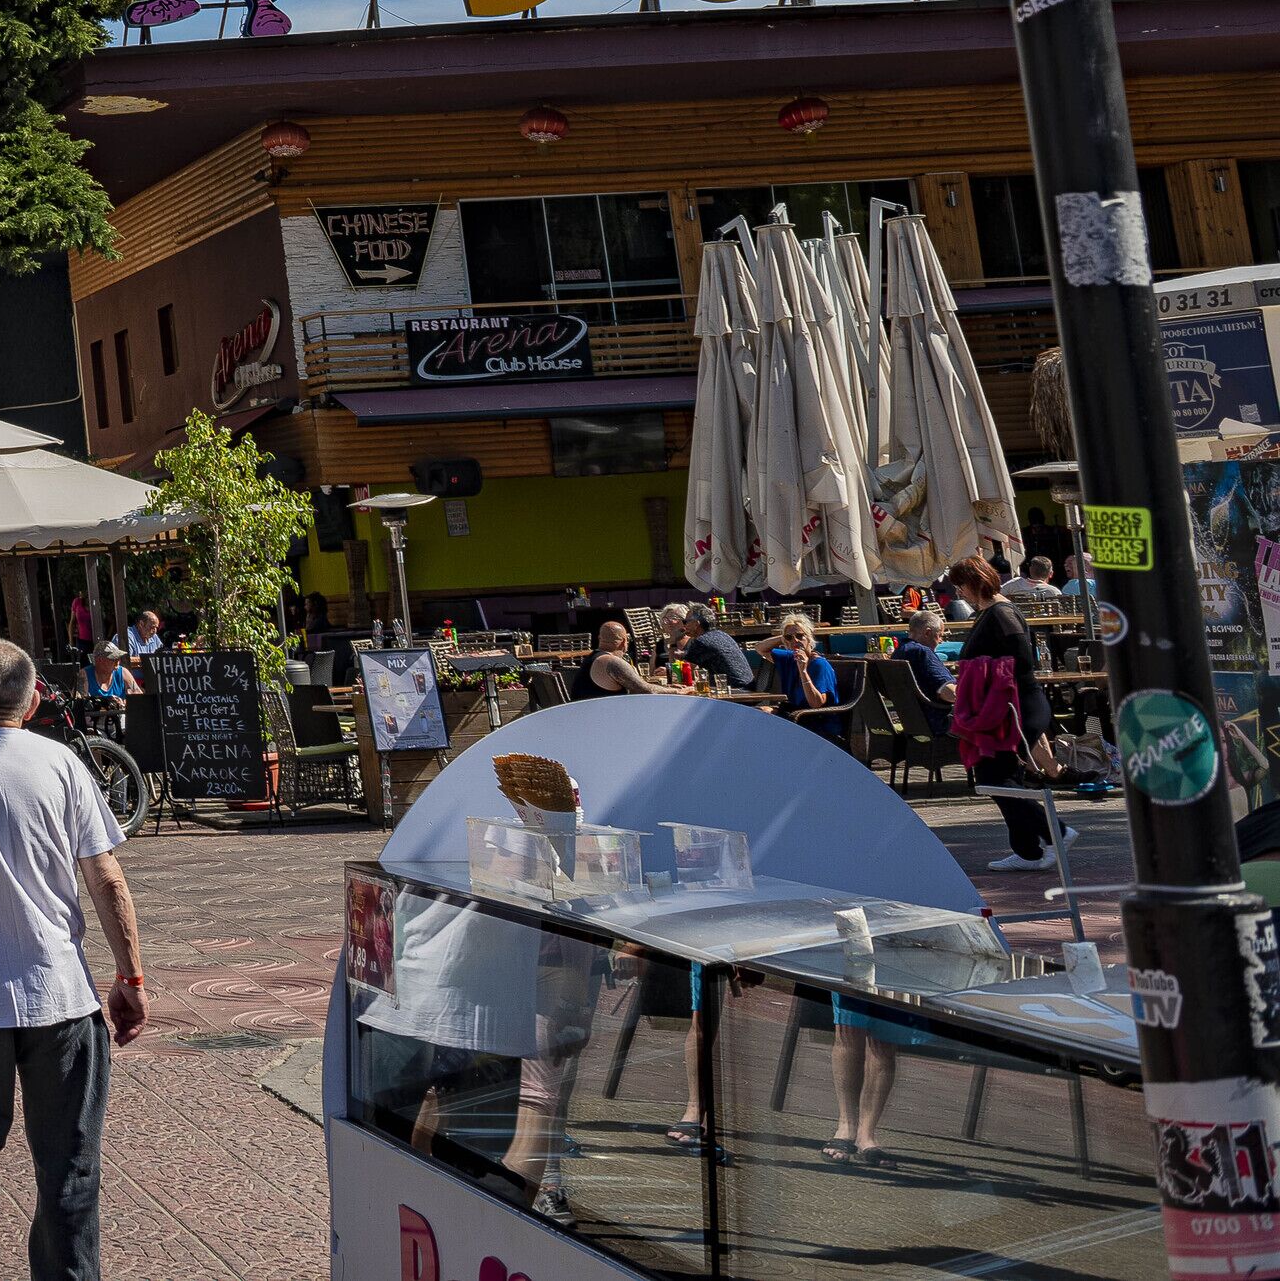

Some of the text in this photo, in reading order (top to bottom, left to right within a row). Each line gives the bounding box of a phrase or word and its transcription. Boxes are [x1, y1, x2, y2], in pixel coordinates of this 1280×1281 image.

[327, 211, 430, 236] CHINESE
[353, 239, 412, 262] FOOD
[1176, 288, 1233, 312] 31 31
[411, 317, 510, 332] RESTAURANT
[435, 321, 569, 369] Arena
[485, 355, 584, 373] Club House
[1166, 360, 1208, 373] URITY
[1086, 510, 1143, 525] LLOCKS
[1093, 524, 1142, 537] BREXIT
[1088, 538, 1145, 553] LLOCKS
[1097, 551, 1140, 565] BORIS
[1212, 624, 1243, 634] ВСИЧКО
[387, 658, 408, 669] MIX
[162, 655, 250, 692] HAPPY 24/7
[165, 675, 216, 694] HOUR
[176, 693, 195, 705] ALL
[166, 705, 188, 720] Buy
[195, 718, 233, 731] FREE
[182, 743, 252, 761] ARENA
[170, 760, 256, 783] KARAOKE
